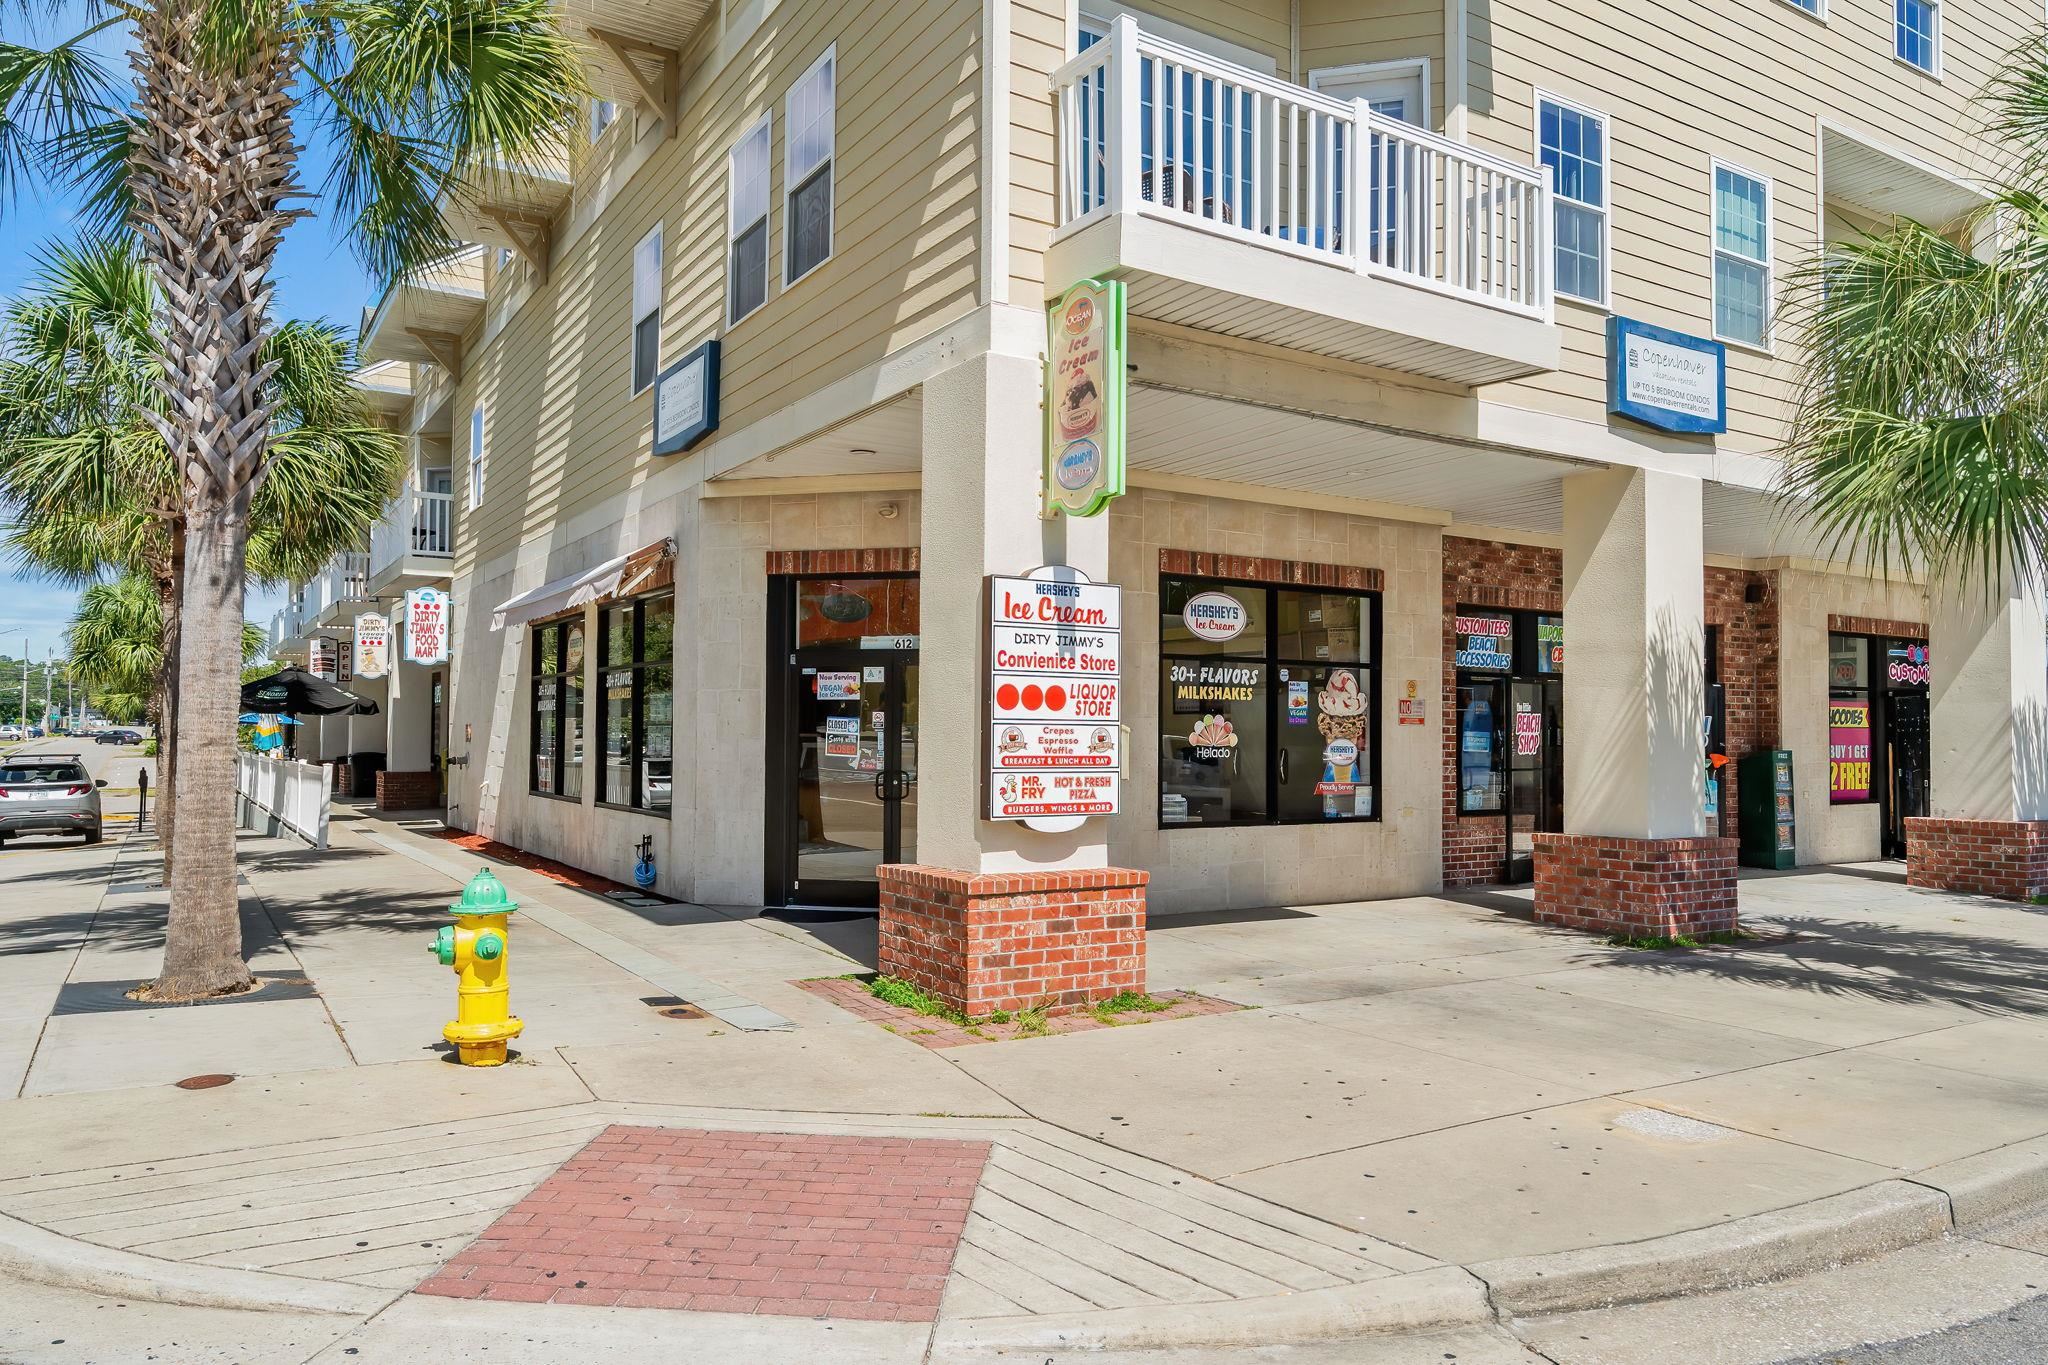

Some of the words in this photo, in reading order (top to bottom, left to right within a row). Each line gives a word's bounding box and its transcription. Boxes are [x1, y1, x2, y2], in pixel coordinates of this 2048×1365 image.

[1066, 311, 1092, 325] OCEAN
[1068, 336, 1089, 353] Ice
[1059, 350, 1099, 375] Cream
[1642, 348, 1706, 375] Copenhaver
[1632, 380, 1640, 389] UP
[1642, 382, 1650, 391] TO
[1656, 386, 1685, 400] BEDROOM
[1686, 393, 1710, 405] CONDOS
[1036, 584, 1080, 597] HERSHEY'S
[1004, 592, 1034, 620] Ice
[1038, 597, 1107, 625] Cream
[1190, 604, 1239, 620] HERSHEY'S
[414, 610, 440, 623] DIRTY
[1195, 618, 1207, 630] Ice
[1208, 620, 1236, 632] Cream
[1489, 620, 1510, 636] TEES
[415, 634, 439, 647] FOOD
[895, 638, 912, 649] 612
[1015, 633, 1051, 645] DIRTY
[1056, 635, 1104, 648] JIMMY'S
[1468, 636, 1497, 652] BEACH
[415, 646, 439, 658] MART
[341, 645, 350, 680] OPEN
[997, 650, 1076, 669] Convienice
[1080, 654, 1116, 671] Store
[834, 673, 857, 682] Serving
[1170, 666, 1197, 682] 30+
[1200, 667, 1259, 686] FLAVORS
[819, 684, 843, 692] VEGAN
[1070, 684, 1116, 700] LIQUOR
[1177, 685, 1254, 701] MILKSHAKES
[1075, 701, 1111, 716] STORE
[1401, 701, 1411, 714] NO
[828, 720, 848, 729] CLOSED
[1516, 713, 1541, 734] BEACH
[1043, 727, 1074, 735] Crepes
[1038, 737, 1079, 745] Espresso
[1518, 734, 1540, 755] SHOP
[828, 745, 857, 755] CLOSED
[1043, 747, 1073, 755] Waffle
[1196, 746, 1231, 760] Helado
[1831, 745, 1845, 758] BUY
[1848, 745, 1852, 758] 1
[1854, 745, 1868, 758] GET
[1005, 757, 1045, 765] BREAKFAST
[1022, 776, 1043, 787] MR.
[1054, 777, 1073, 788] HOT
[1075, 777, 1083, 787] &
[1084, 776, 1112, 788] FRESH
[1831, 762, 1838, 790] 2
[1022, 787, 1046, 799] FRY
[1069, 788, 1097, 800] PIZZA
[1319, 784, 1337, 792] Proudly
[1051, 804, 1078, 812] WINGS
[1088, 803, 1111, 811] MORE
